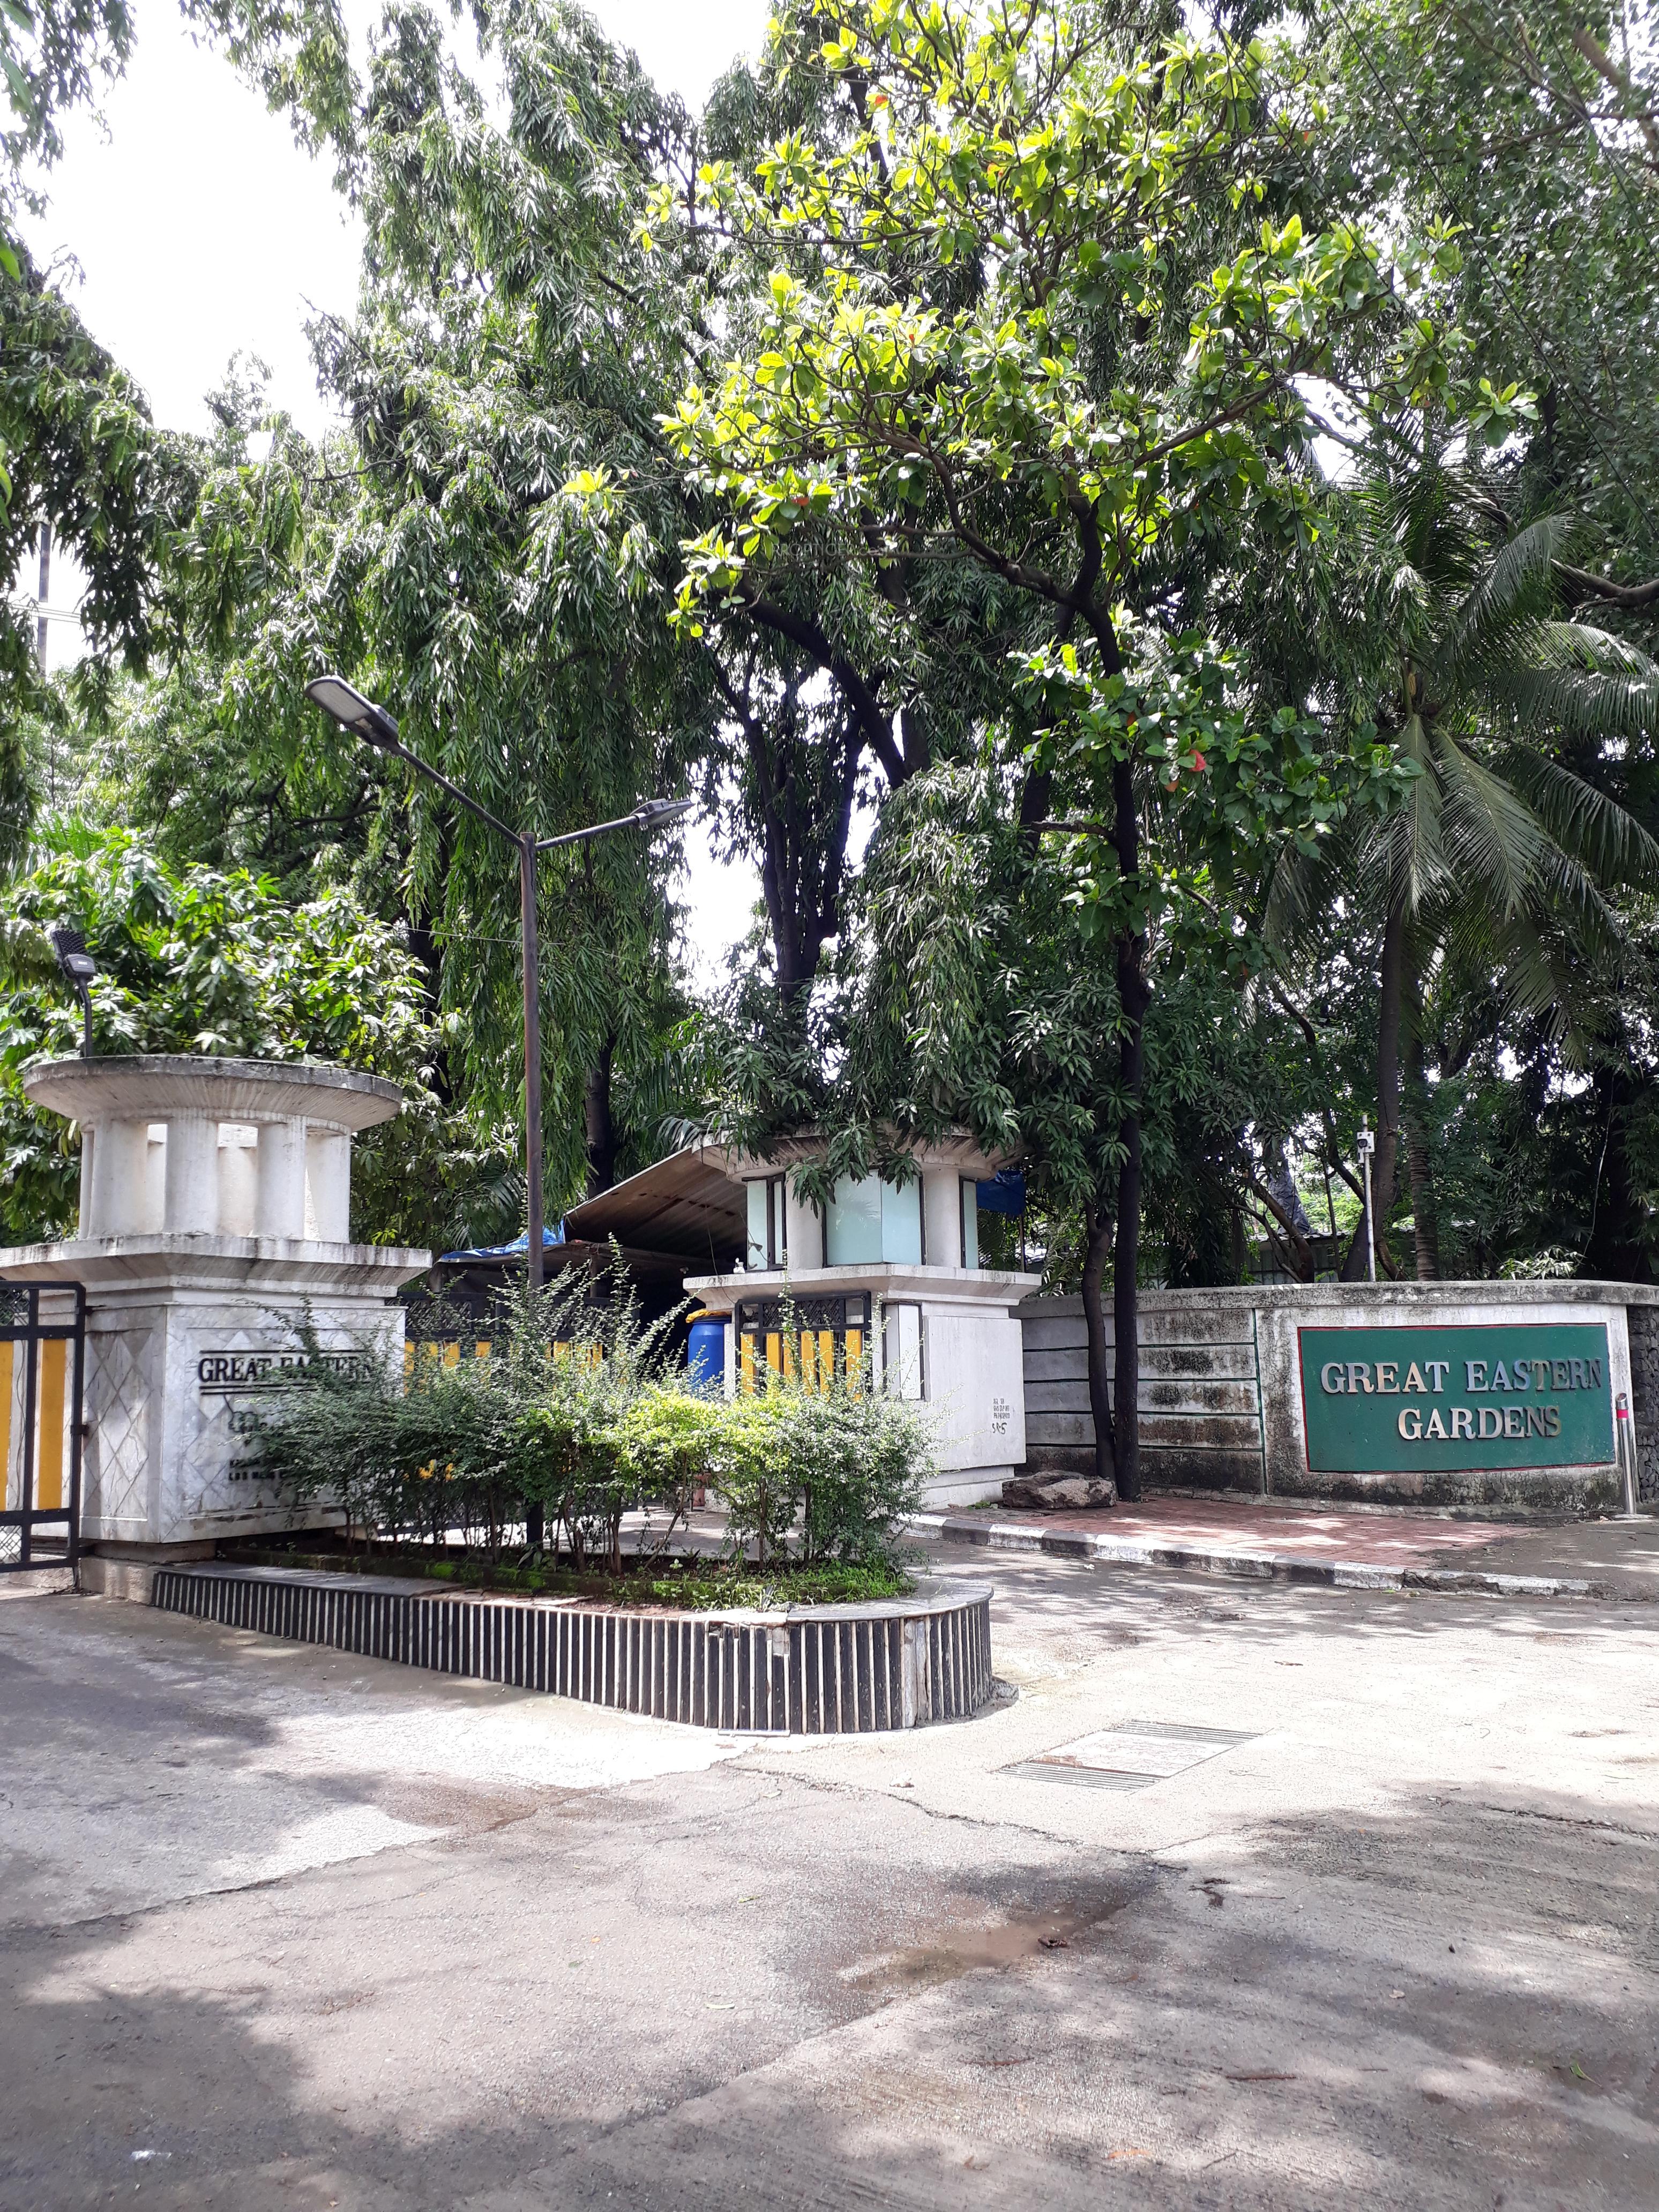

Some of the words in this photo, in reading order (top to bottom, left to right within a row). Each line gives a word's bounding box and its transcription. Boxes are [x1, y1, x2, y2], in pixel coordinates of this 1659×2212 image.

[1320, 1361, 1449, 1394] GREAT
[1464, 1357, 1603, 1392] EASTERN
[1397, 1406, 1561, 1440] GARDENS
